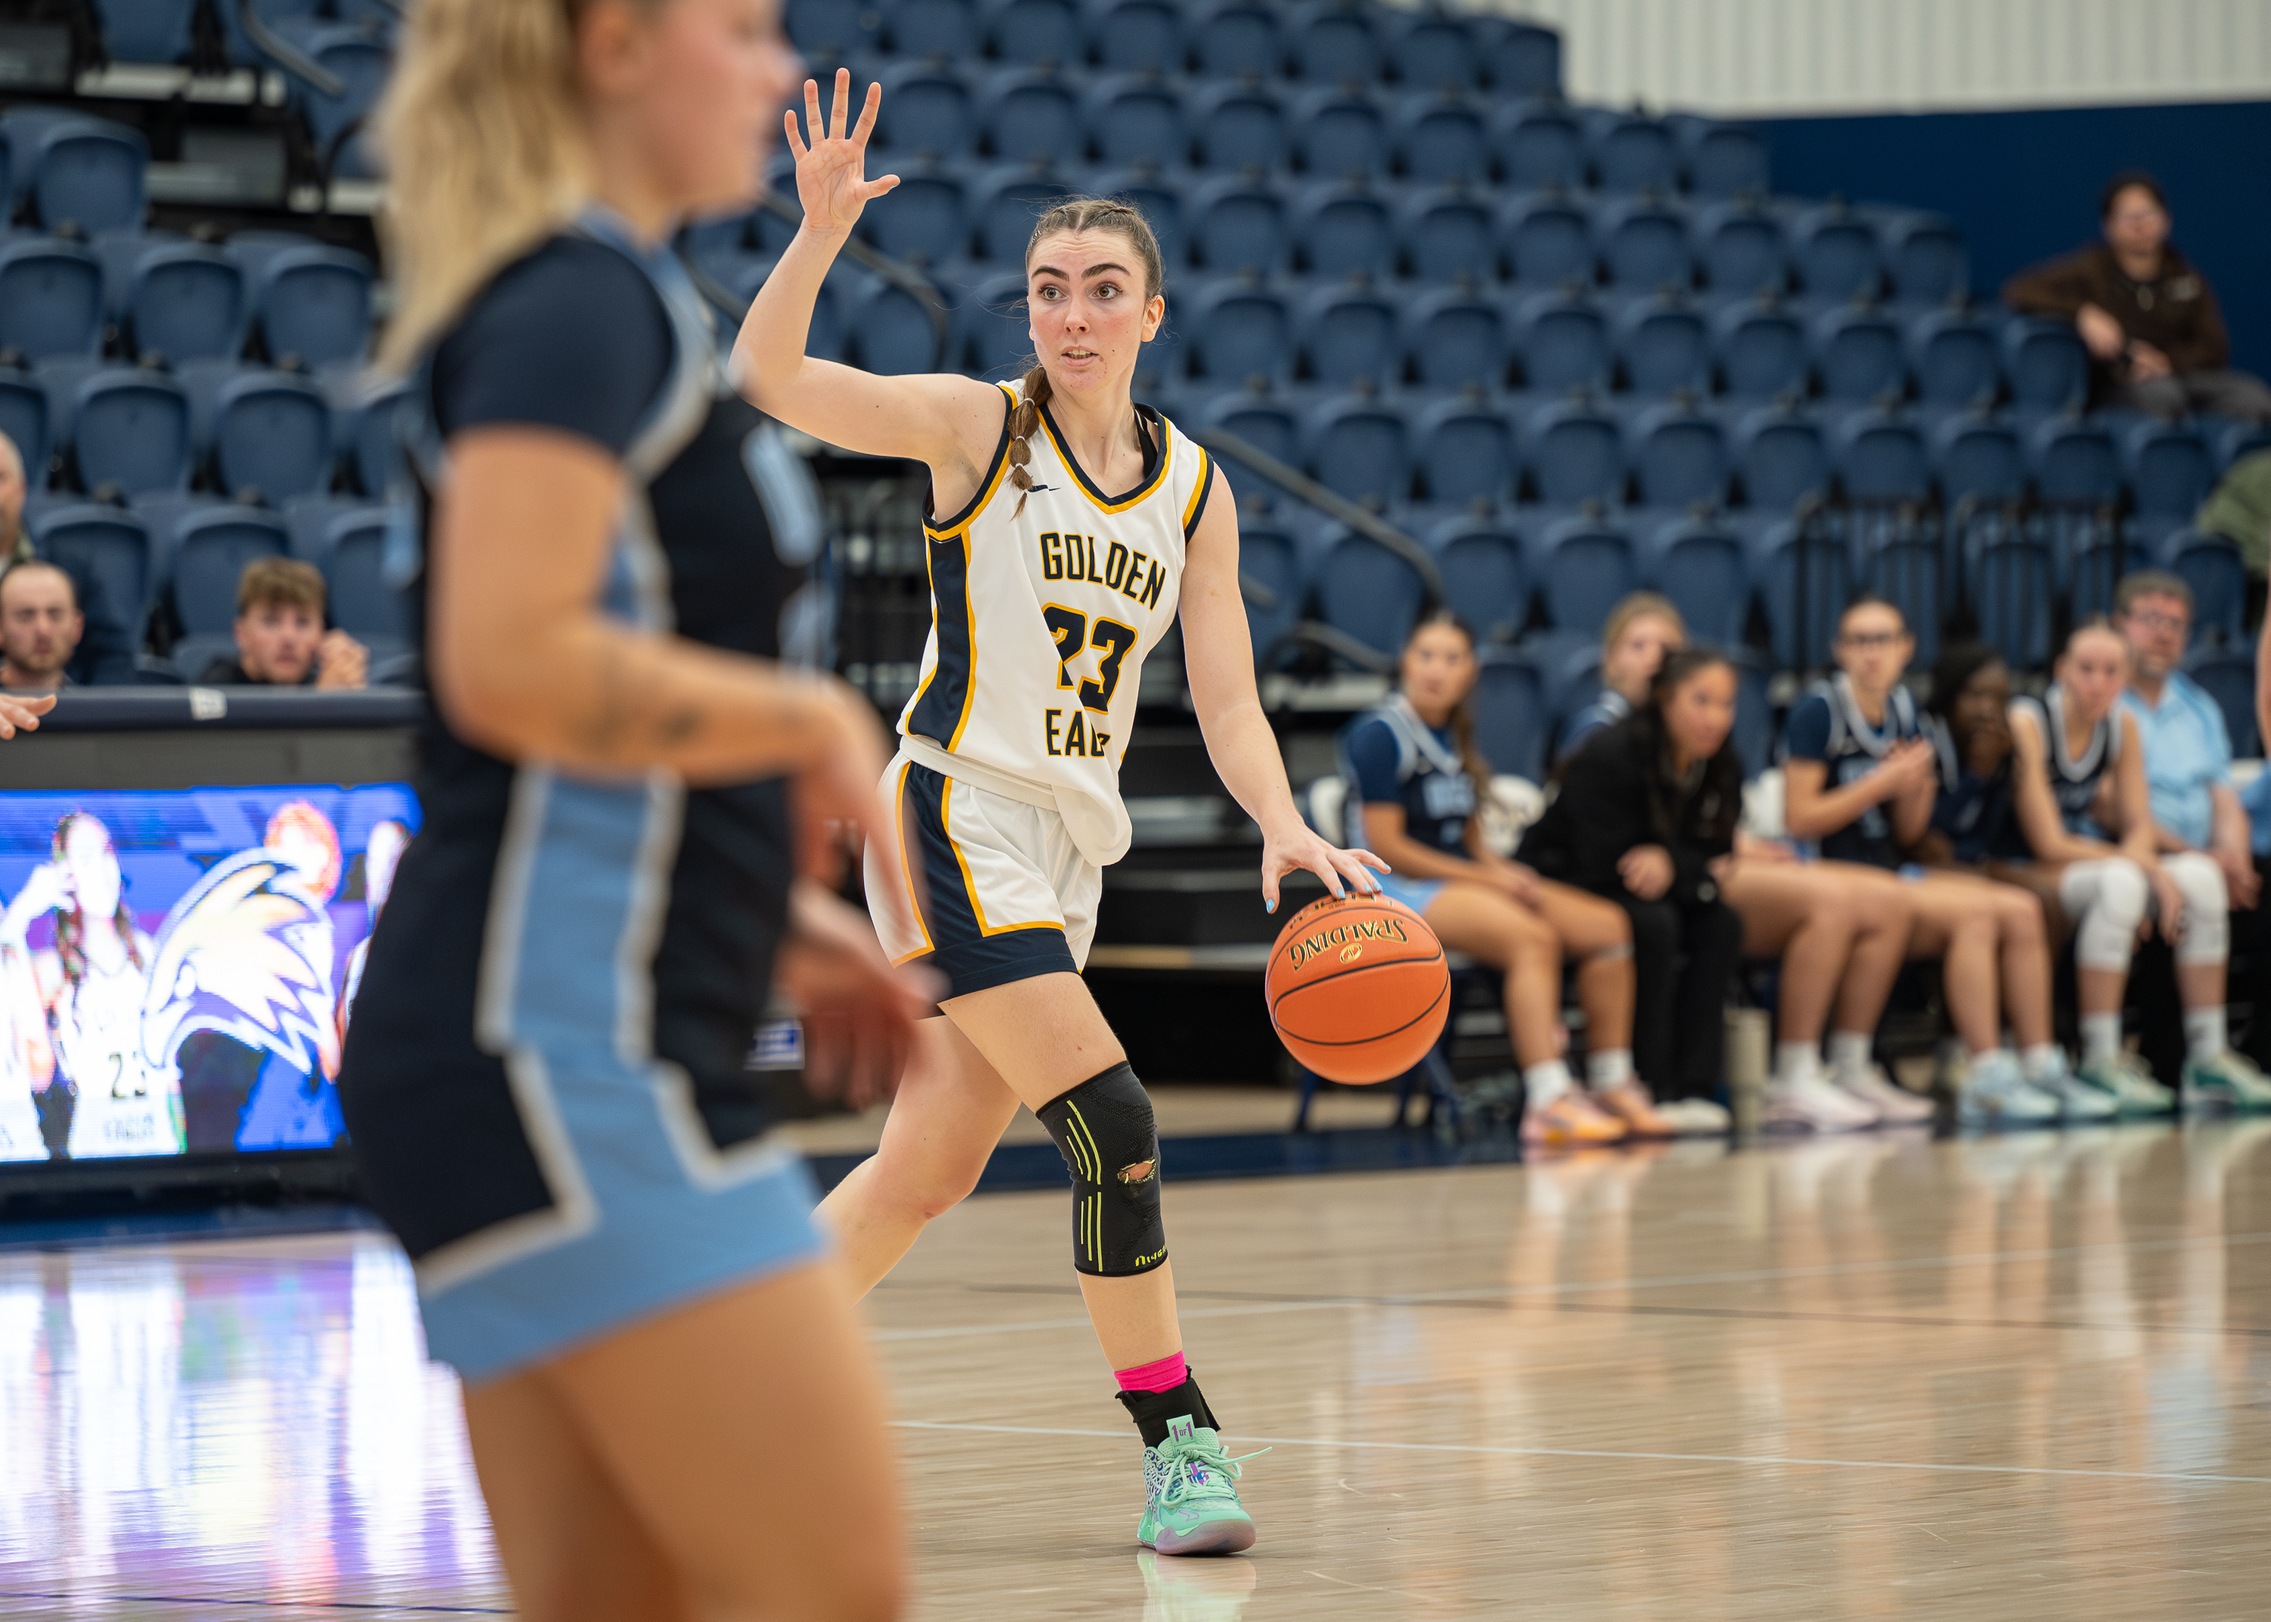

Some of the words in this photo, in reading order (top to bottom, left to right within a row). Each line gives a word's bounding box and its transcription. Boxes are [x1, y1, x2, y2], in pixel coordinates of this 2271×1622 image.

[1040, 532, 1166, 612] GOLDEN
[1289, 919, 1408, 971] SPALDING
[1172, 1425, 1179, 1443] 1
[1186, 1421, 1193, 1439] 1
